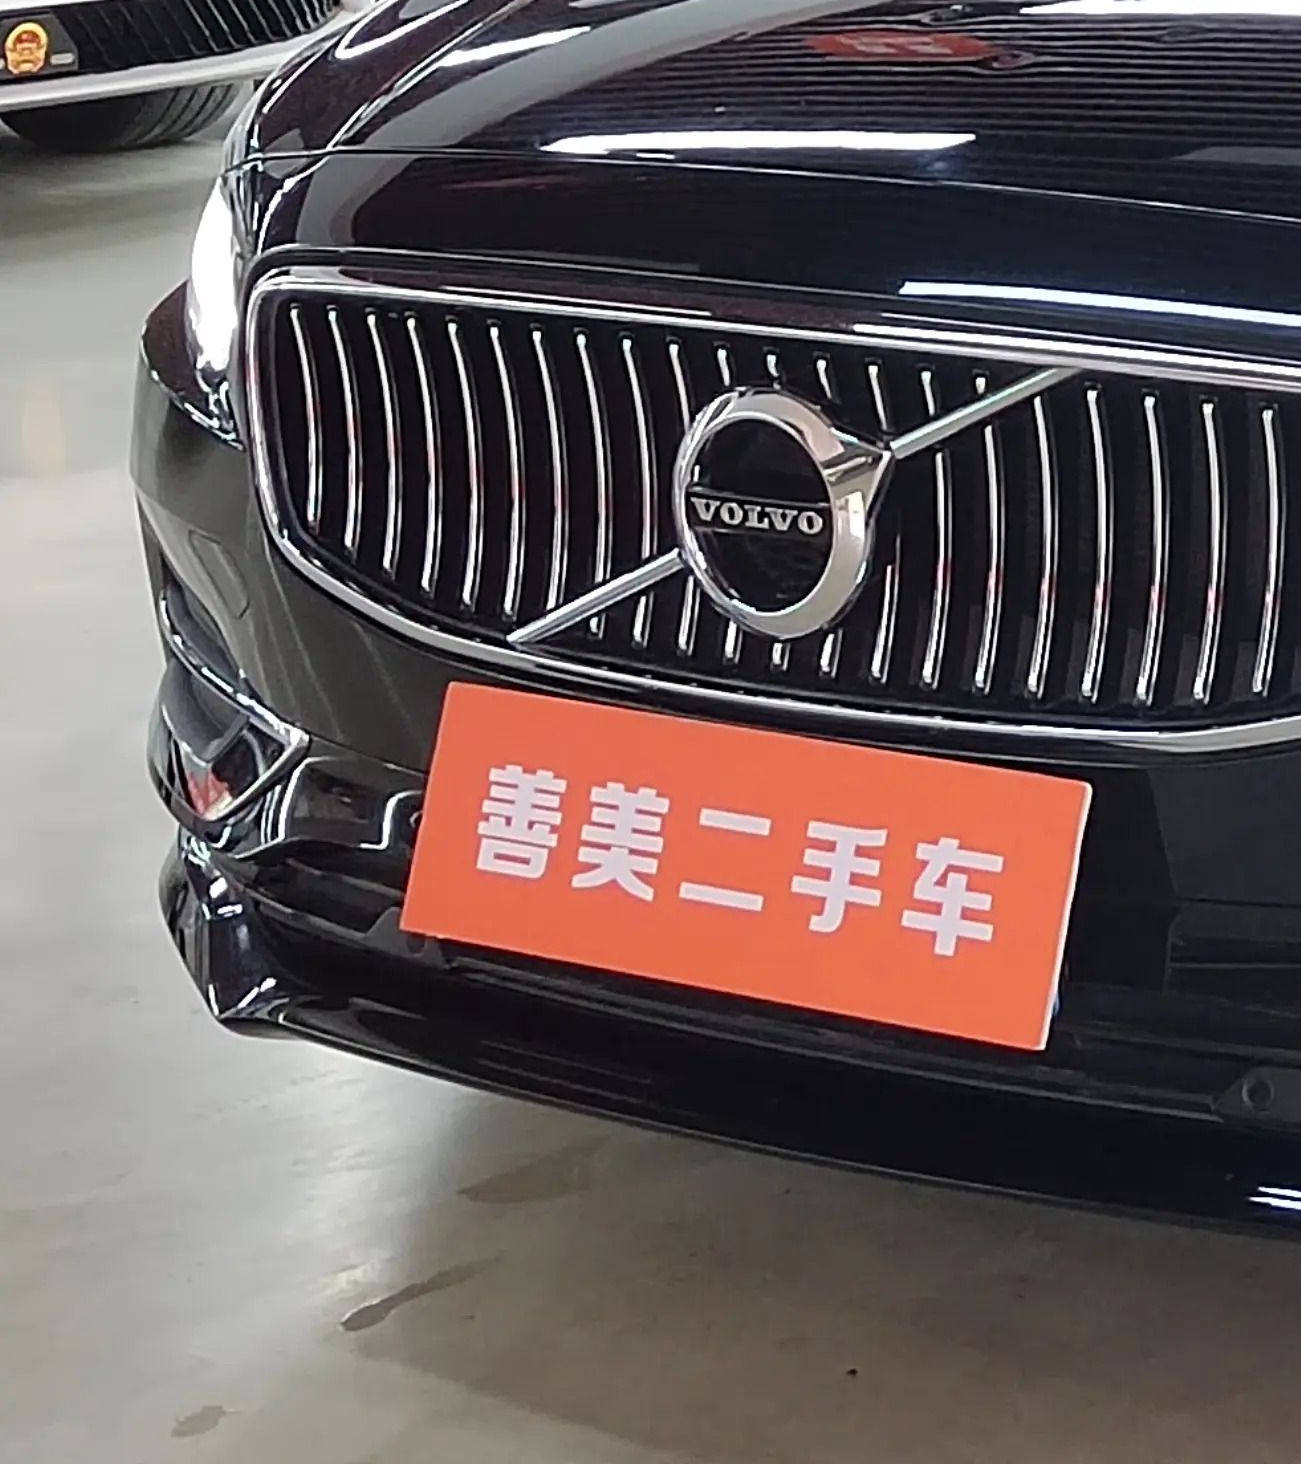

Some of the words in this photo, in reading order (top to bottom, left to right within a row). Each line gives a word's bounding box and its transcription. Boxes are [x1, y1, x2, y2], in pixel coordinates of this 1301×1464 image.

[690, 496, 824, 535] VOLVO
[475, 762, 1004, 957] 善美二手车
